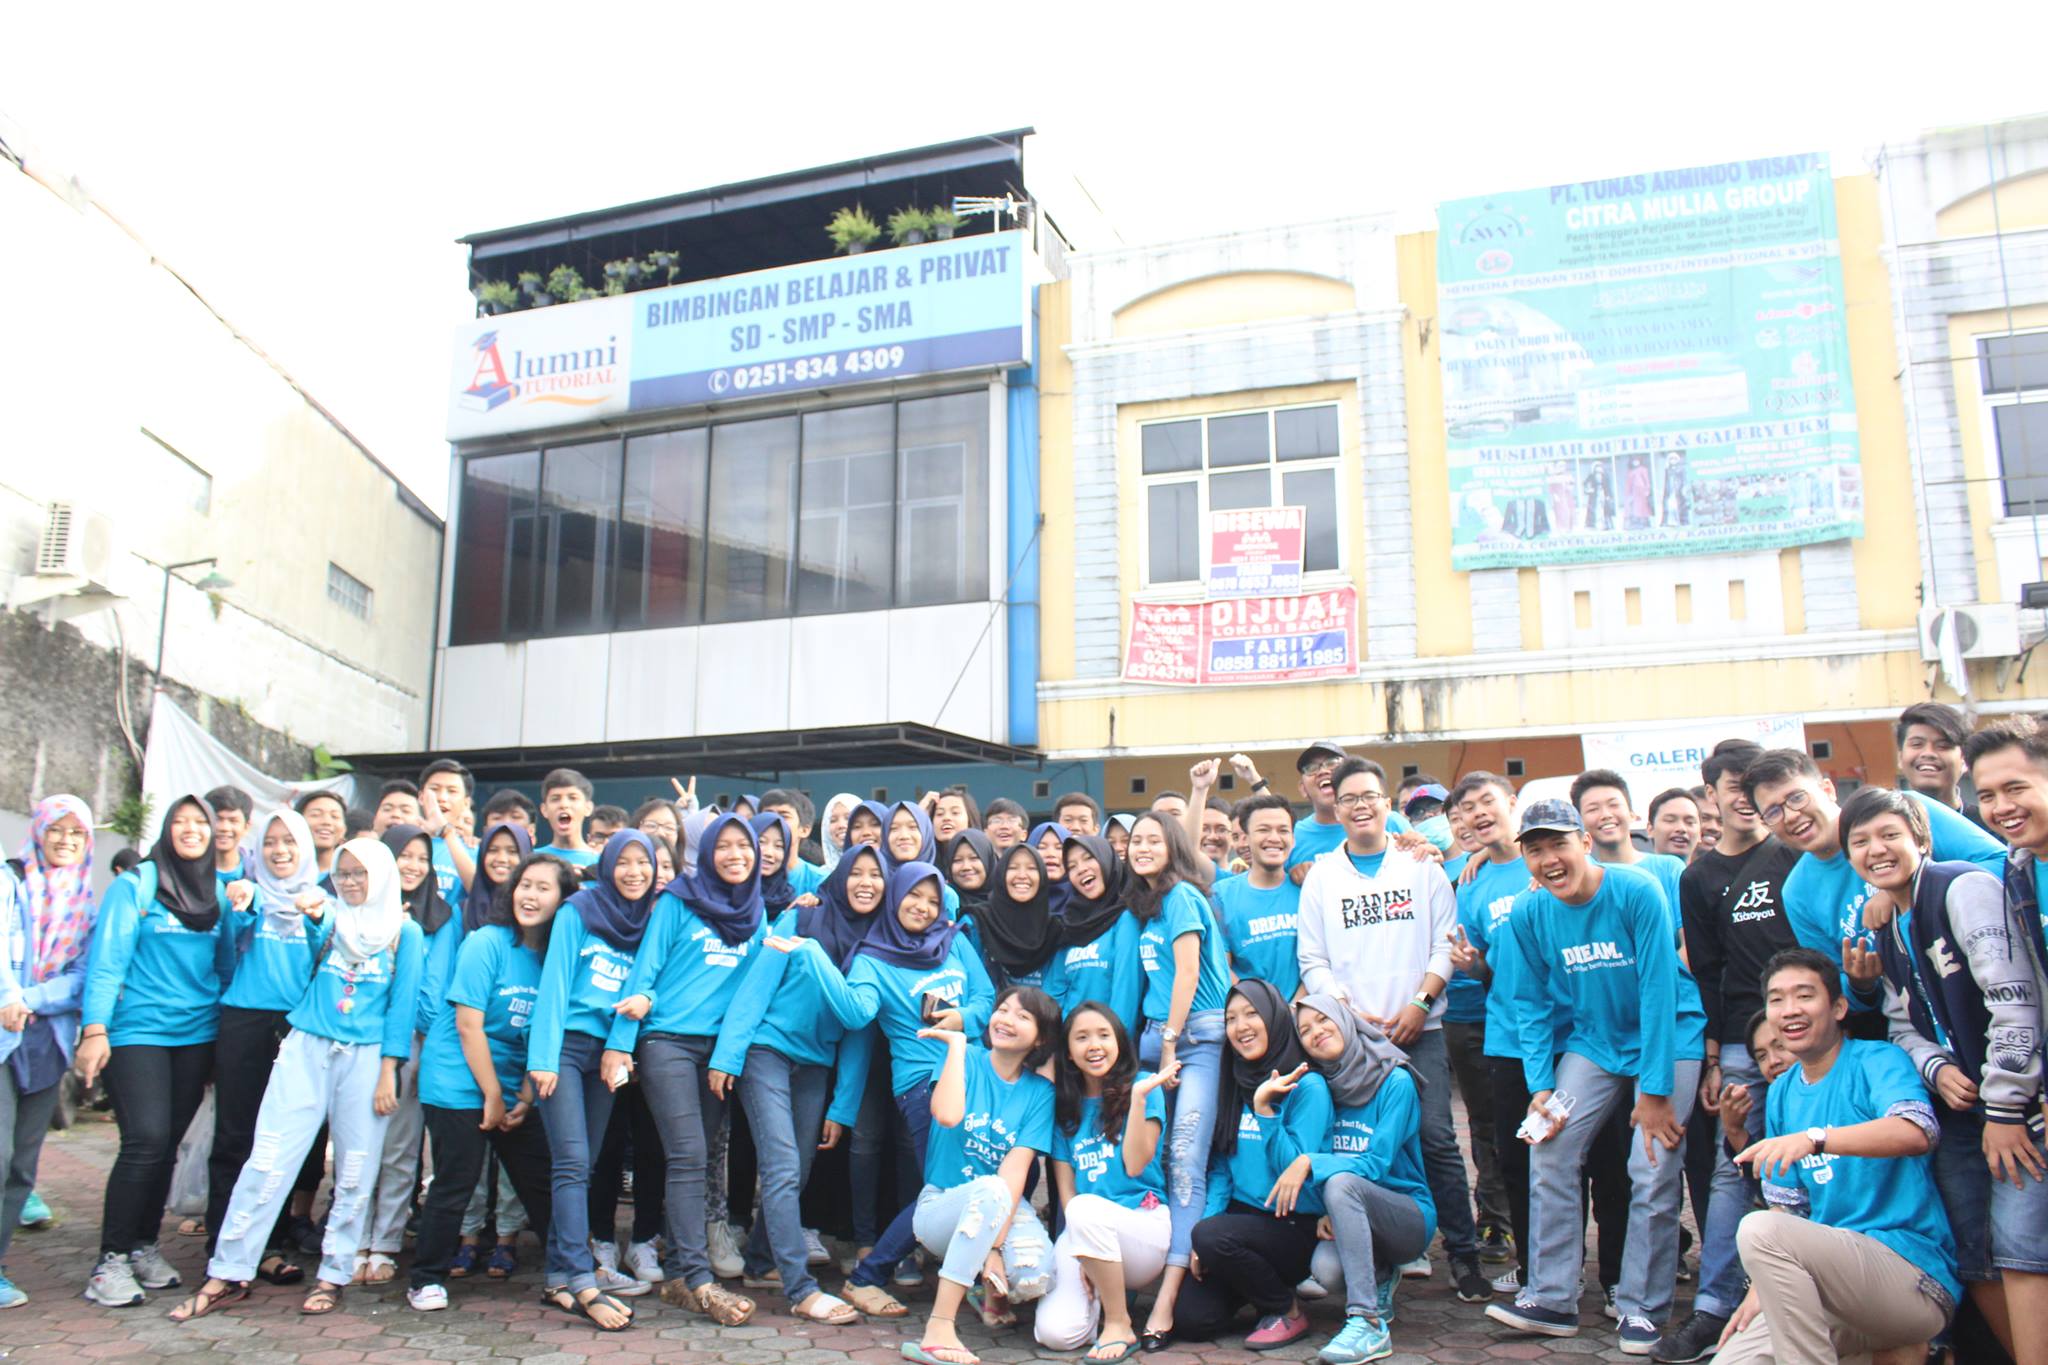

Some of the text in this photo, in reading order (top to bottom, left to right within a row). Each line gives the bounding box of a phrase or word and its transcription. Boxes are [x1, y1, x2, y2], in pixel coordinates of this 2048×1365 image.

[1583, 174, 1646, 201] TUNAS
[1652, 161, 1742, 193] ARMINDO
[1566, 179, 1811, 232] CITRA MULIA GROUP
[647, 246, 1010, 328] BIMBINGAN BELAJAR & PRIVAT
[1512, 272, 1568, 289] PESANAN
[731, 324, 761, 352] SD
[782, 312, 836, 344] SMP
[857, 300, 913, 333] SMA
[465, 335, 617, 391] Alumni
[733, 345, 905, 389] 0251-834 4309
[522, 368, 616, 395] TUTORIAL
[1478, 416, 1829, 463] MUSLIMAH OUTLET & GALERY UKM
[1213, 510, 1300, 533] DISEWA
[1479, 540, 1524, 552] MEDIA
[1211, 594, 1347, 627] DIJUAL
[1212, 616, 1346, 637] LOKASI BAGUS
[1244, 637, 1314, 654] FARID
[1213, 648, 1343, 671] 0858 8811 1985
[1732, 909, 1776, 923] Xiaoyou
[1925, 936, 1962, 978] E
[1988, 985, 2027, 1002] NOW
[508, 997, 535, 1016] DRE
[1333, 1135, 1370, 1152] REAM
